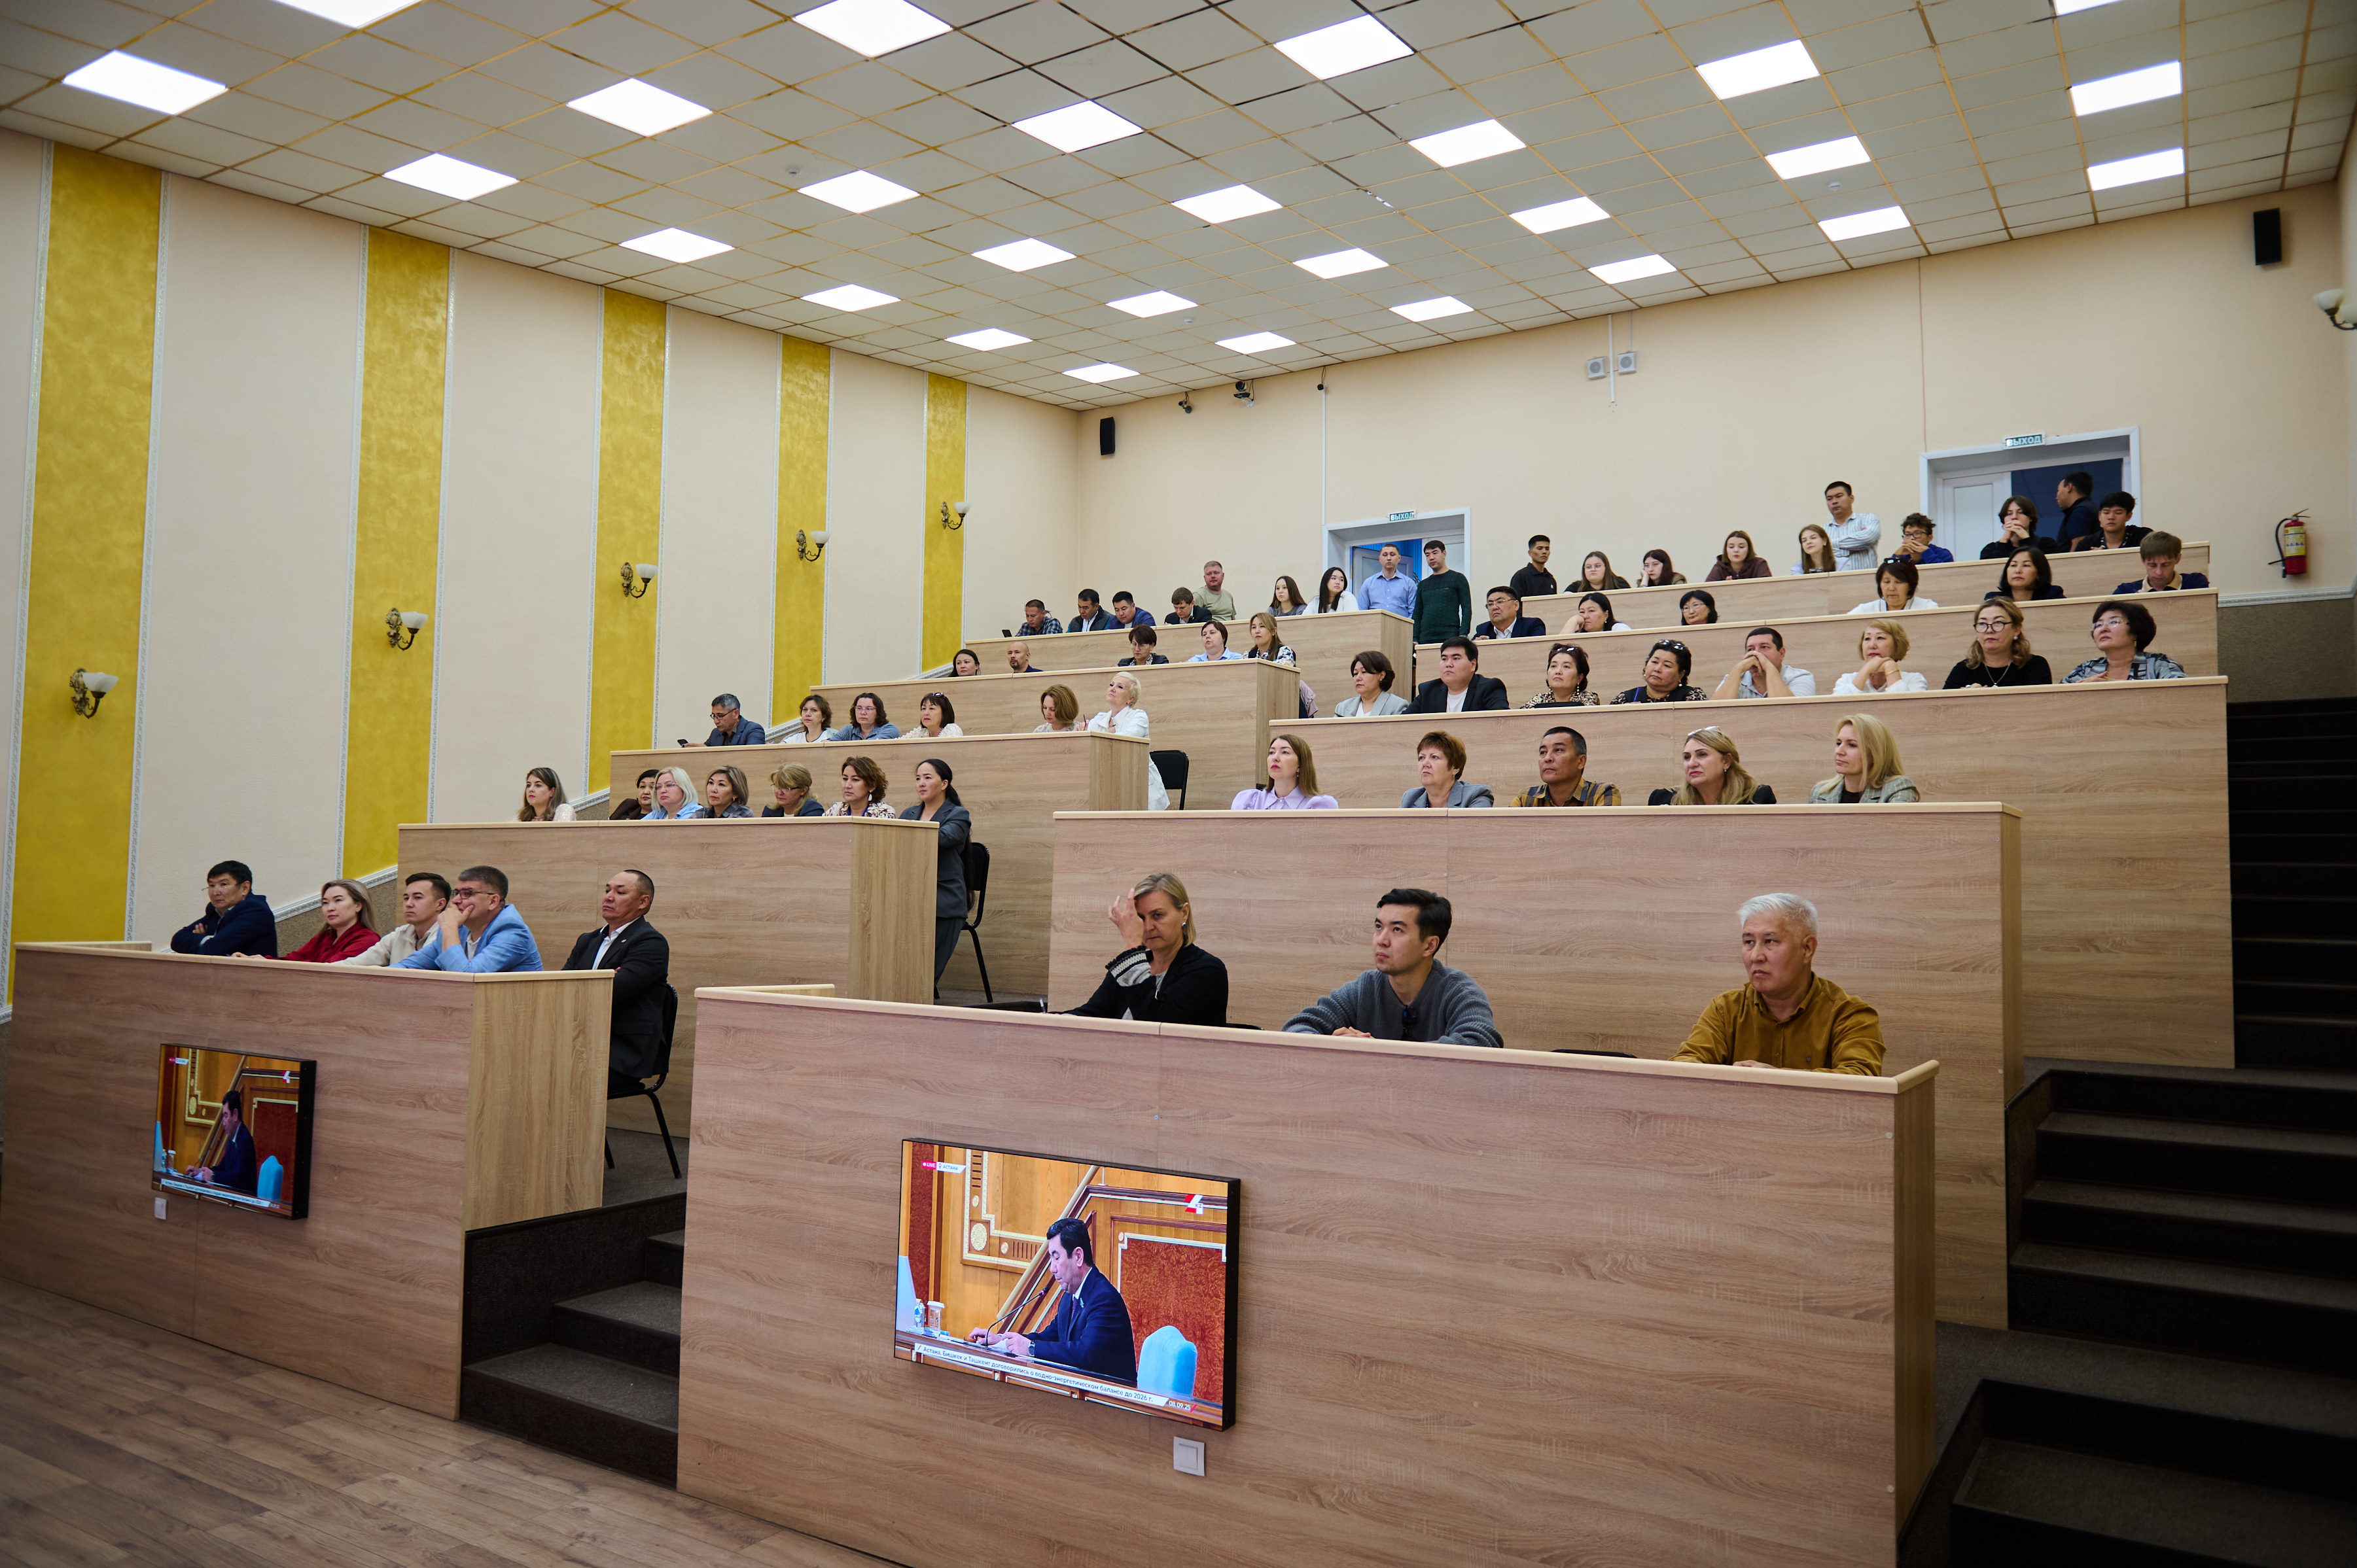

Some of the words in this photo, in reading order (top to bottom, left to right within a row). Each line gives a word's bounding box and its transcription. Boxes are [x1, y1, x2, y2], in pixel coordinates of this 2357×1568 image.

[2006, 436, 2042, 447] ВЫХОД
[1391, 512, 1414, 521] ВЫХОД
[923, 1347, 941, 1356] Астана,
[942, 1351, 963, 1361] Бишкек
[968, 1357, 990, 1366] Ташкент
[991, 1363, 1029, 1375] договорились
[1035, 1372, 1099, 1390] водно-энергетическом
[1100, 1385, 1124, 1396] балансе
[1169, 1401, 1191, 1410] 08.09.25
